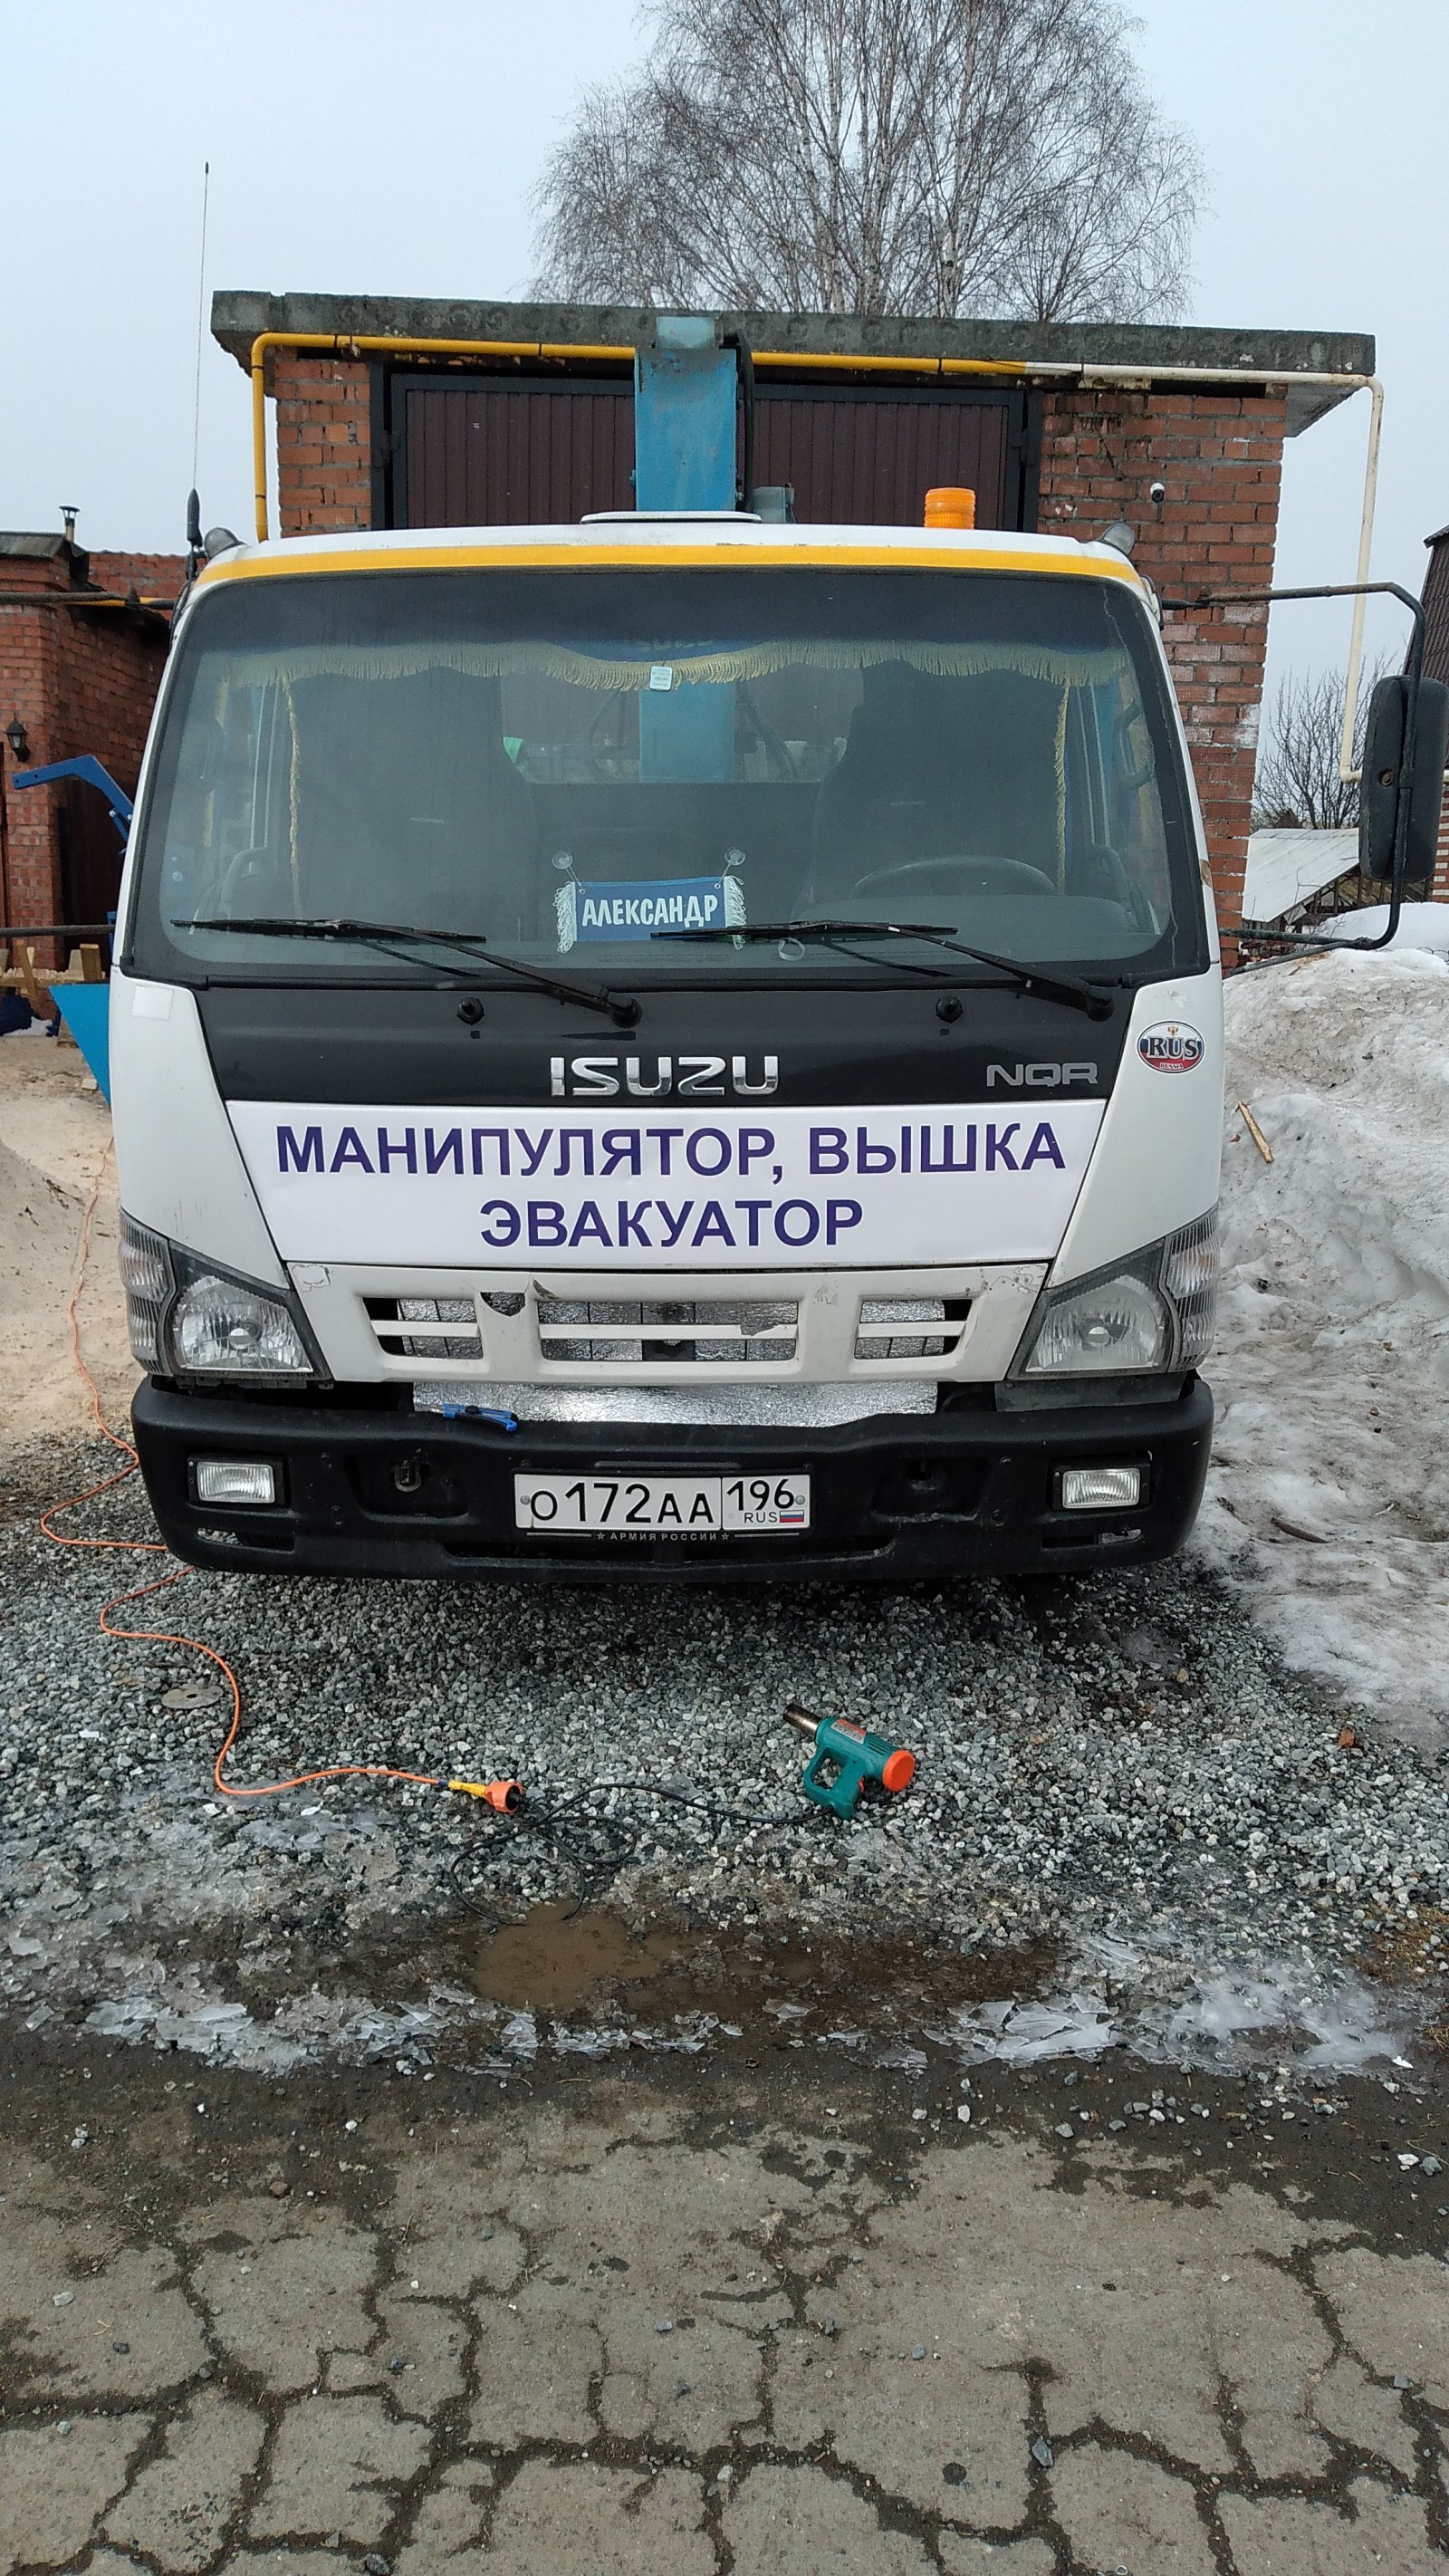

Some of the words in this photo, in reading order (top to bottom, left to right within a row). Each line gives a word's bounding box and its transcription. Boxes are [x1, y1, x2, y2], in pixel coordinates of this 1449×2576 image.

[582, 895, 718, 928] АЛЕКСАНДР
[1147, 1037, 1198, 1060] RUS
[551, 1055, 778, 1096] ISUZU
[986, 1062, 1099, 1087] NQR
[276, 1125, 783, 1185] МАНИПУЛЯТОР,
[809, 1121, 1067, 1175] ВЫШКА
[480, 1198, 863, 1247] ЭВАКУАТОР
[530, 1482, 714, 1523] О172АА
[726, 1478, 794, 1511] 196
[744, 1512, 778, 1523] RUS
[609, 1533, 657, 1541] АРМИЯ
[661, 1533, 717, 1541] РОССИИ
